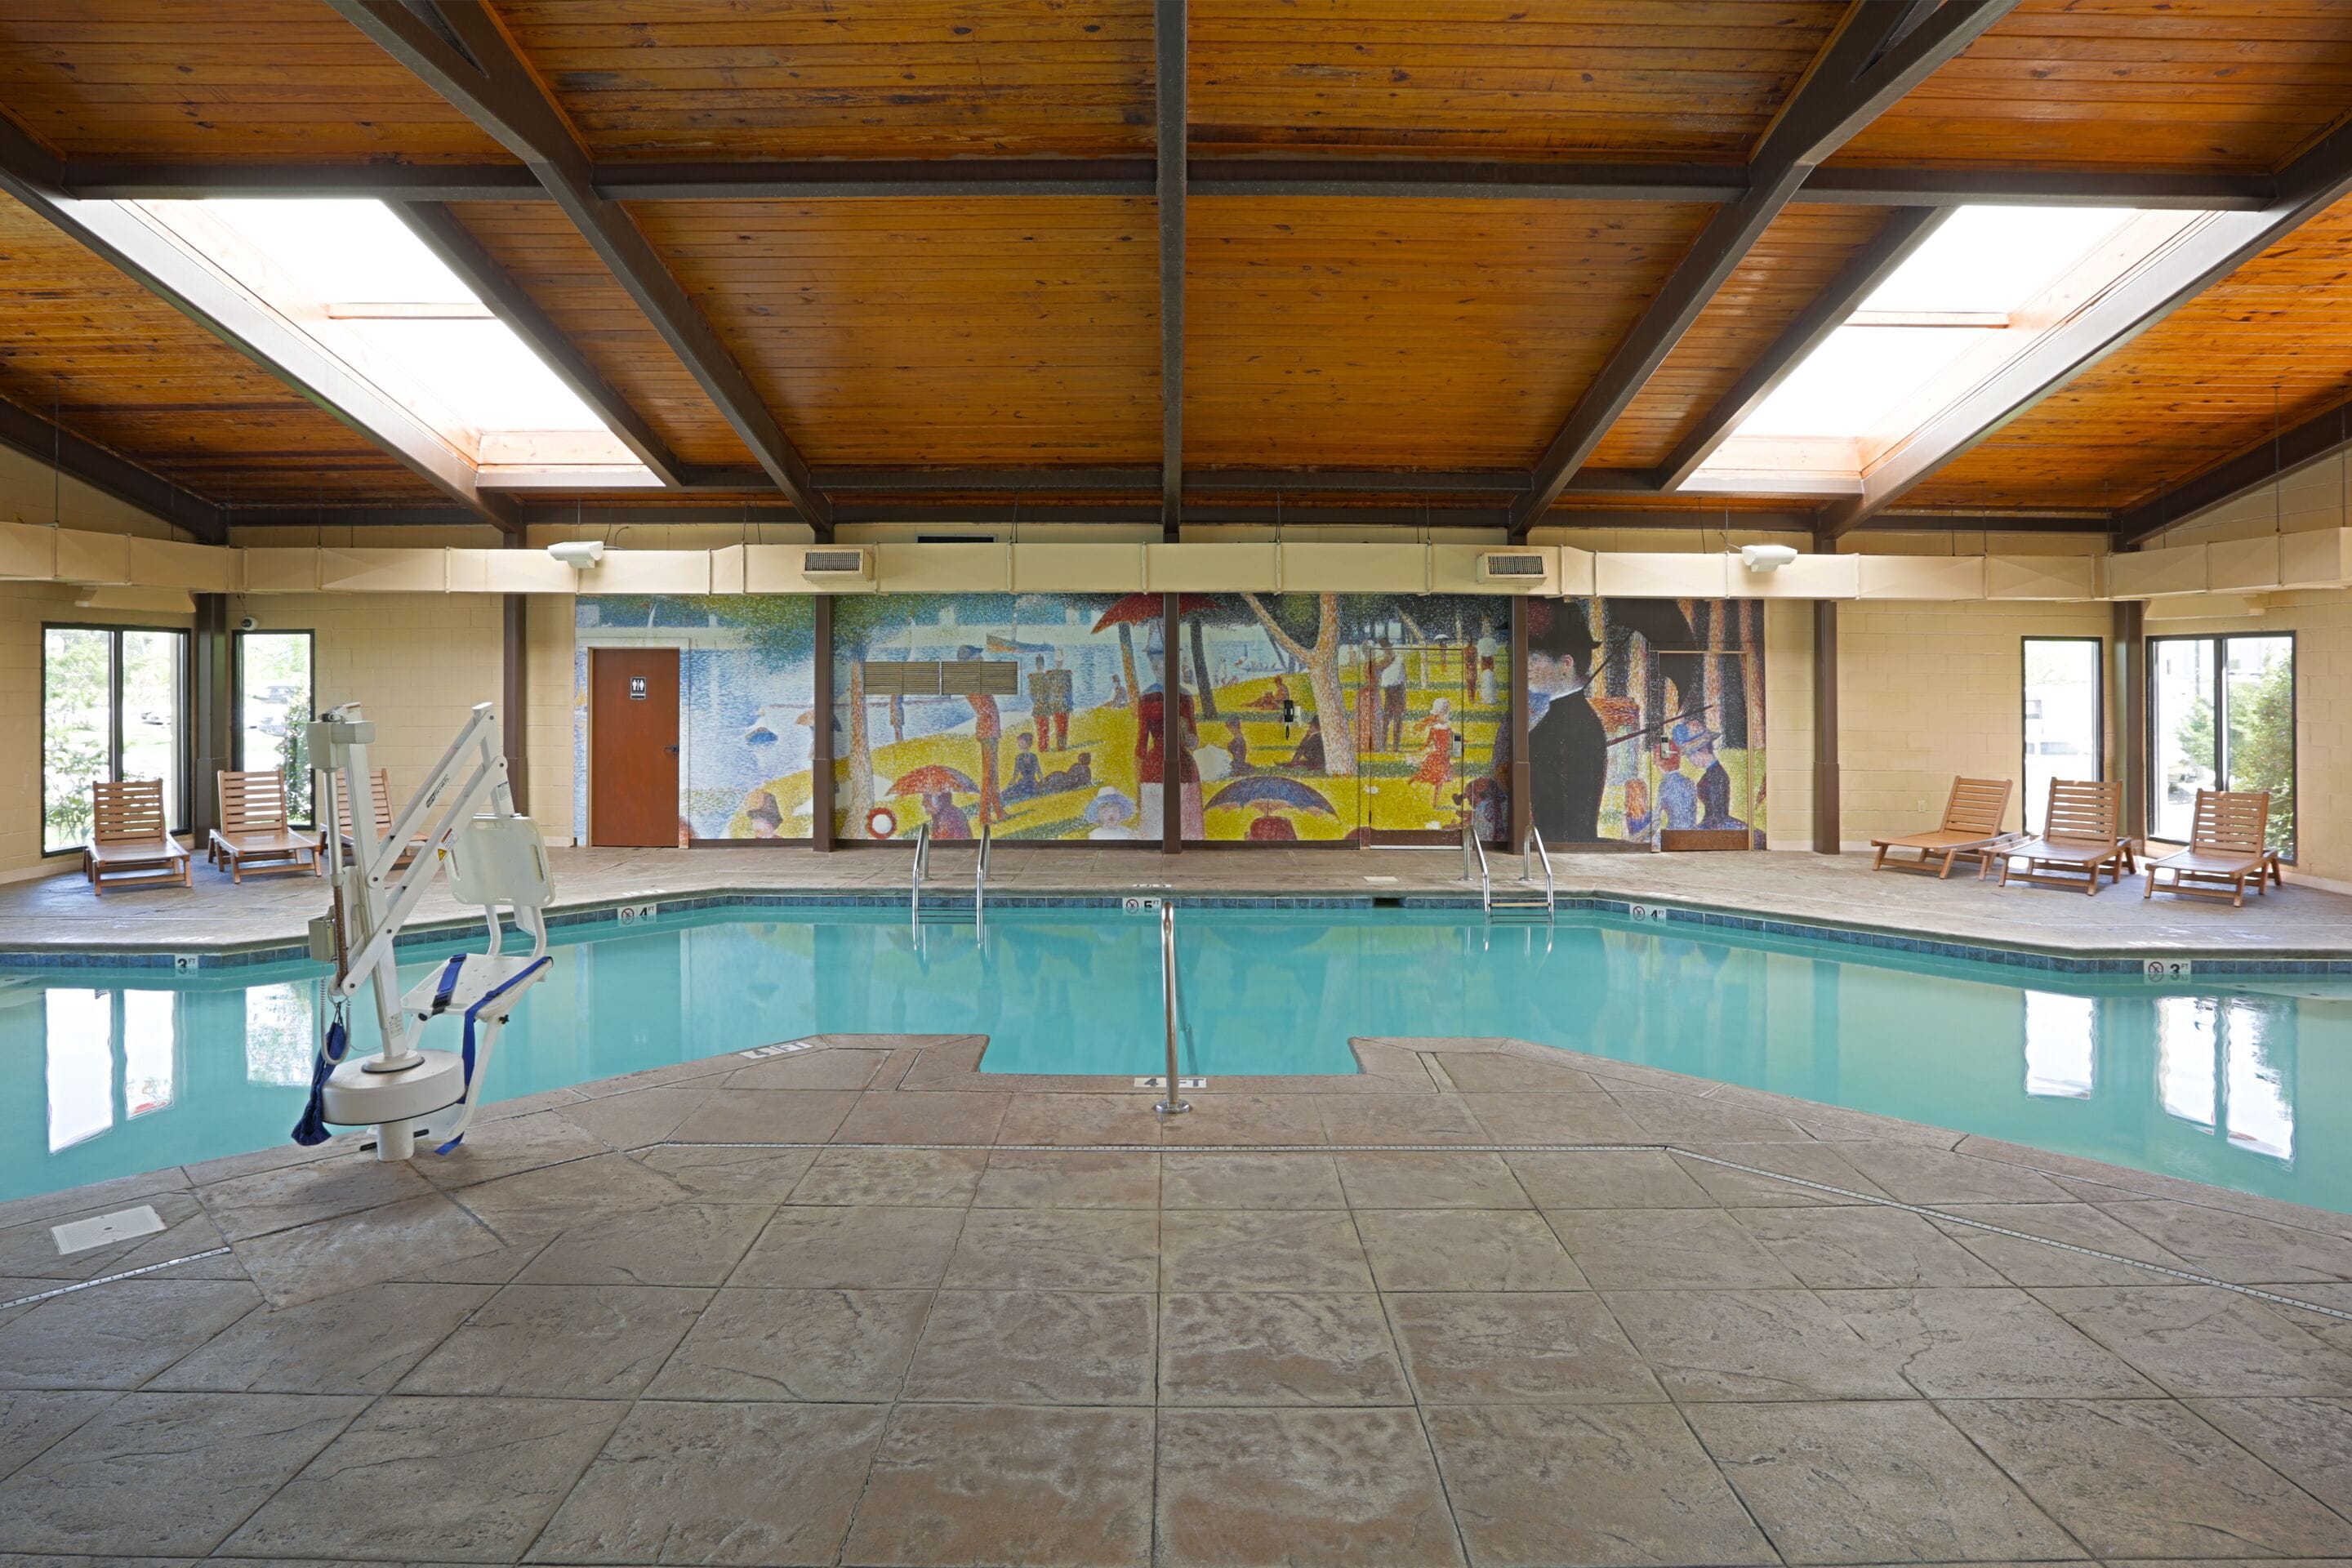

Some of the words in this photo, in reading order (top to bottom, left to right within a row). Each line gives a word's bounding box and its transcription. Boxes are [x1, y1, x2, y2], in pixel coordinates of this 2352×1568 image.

[1144, 900, 1152, 908] 5
[639, 906, 648, 916] 4
[1650, 909, 1658, 918] 4
[177, 958, 188, 969] 3
[2170, 964, 2180, 973] 3
[773, 1041, 805, 1052] FT
[1143, 1078, 1159, 1087] 4
